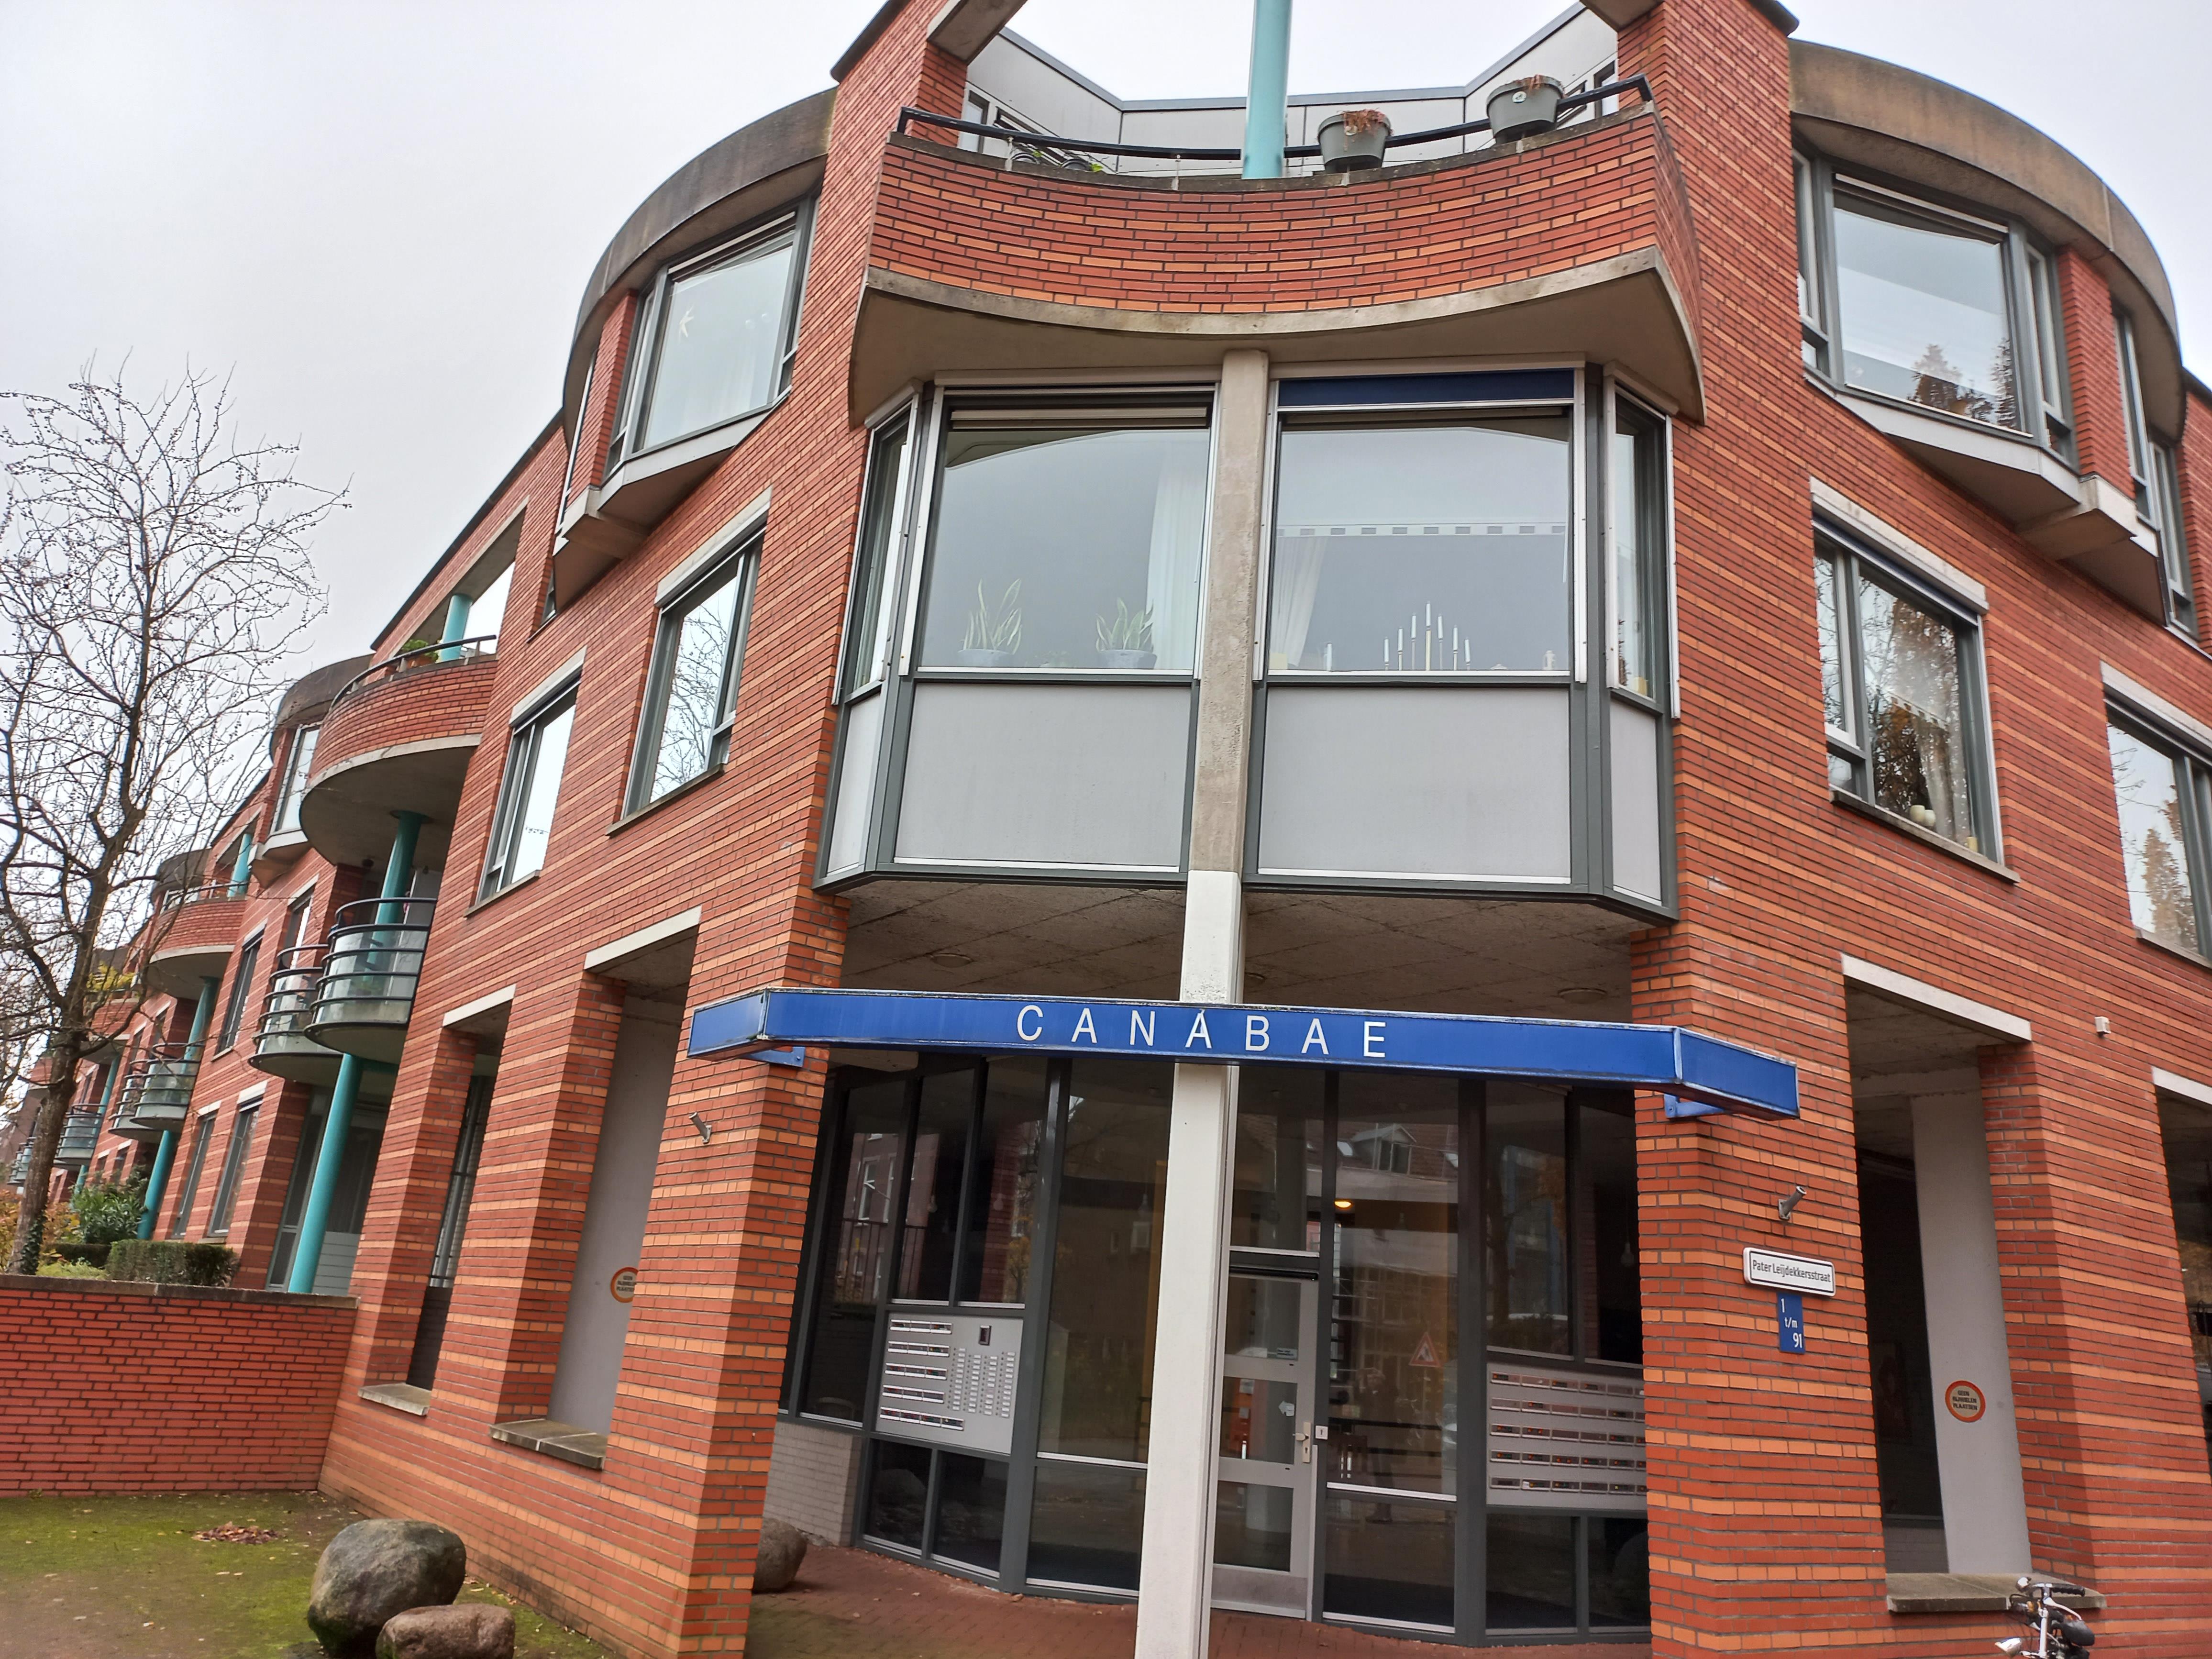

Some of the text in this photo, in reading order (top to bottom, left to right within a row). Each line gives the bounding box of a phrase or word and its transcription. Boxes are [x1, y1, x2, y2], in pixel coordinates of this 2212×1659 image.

[1017, 1005, 1387, 1058] CANABAE
[1752, 1260, 1831, 1283] Pater Leijdekkersstraat
[1781, 1298, 1785, 1313] 1
[1784, 1317, 1798, 1328] t/m
[1793, 1332, 1803, 1348] 91
